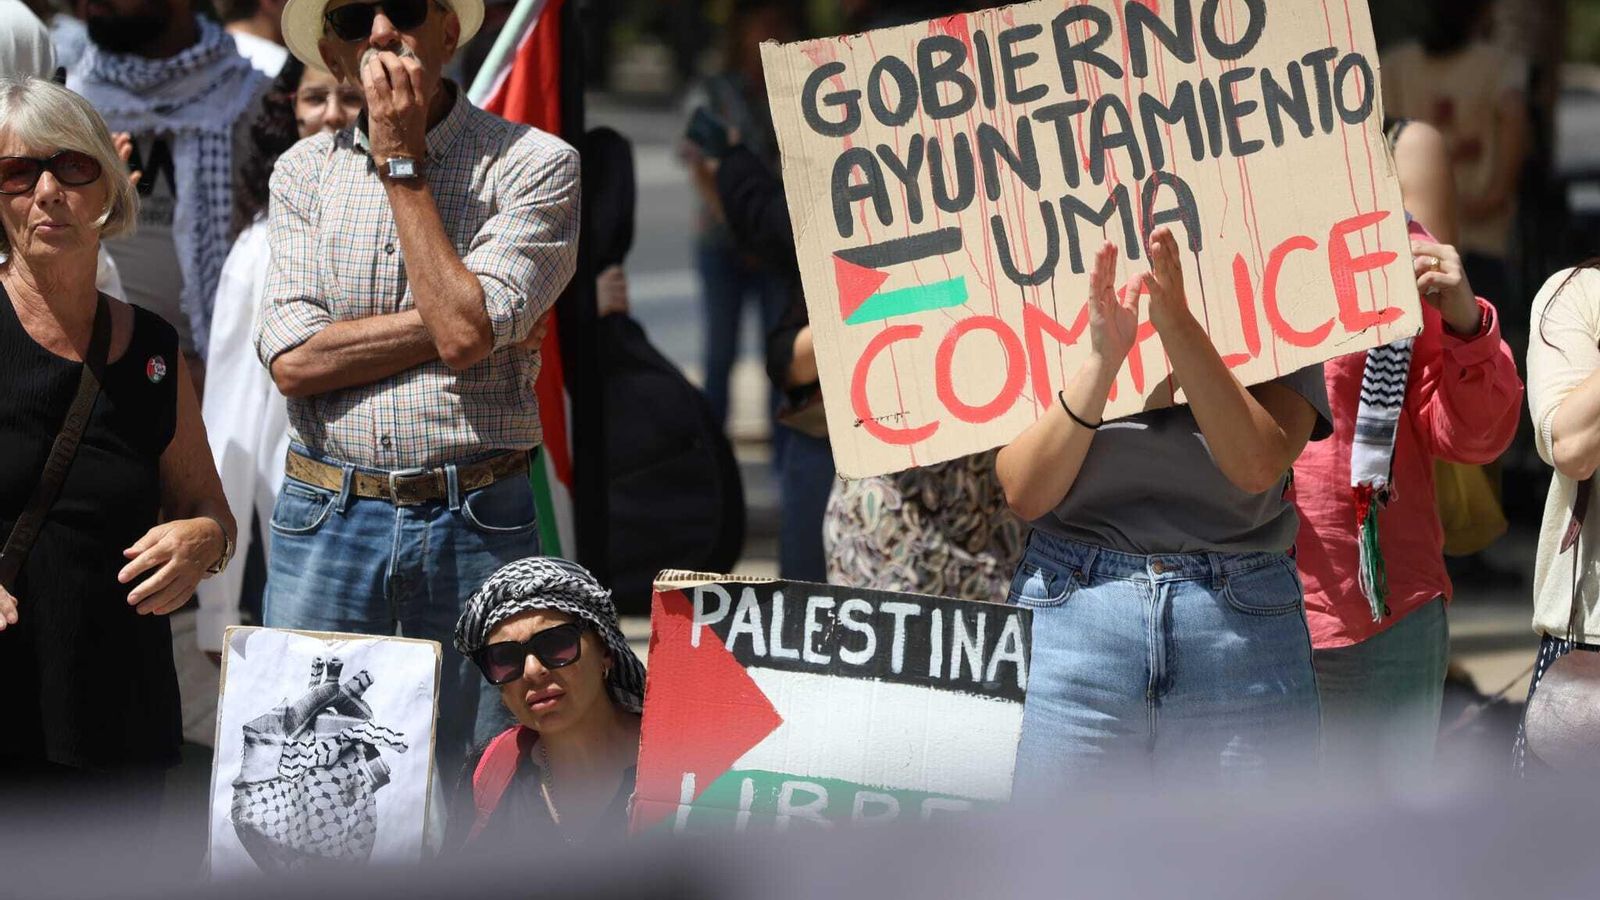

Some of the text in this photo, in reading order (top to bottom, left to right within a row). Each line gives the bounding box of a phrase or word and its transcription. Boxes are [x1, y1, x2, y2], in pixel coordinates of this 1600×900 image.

[801, 0, 1268, 138] GOBIERNO
[830, 46, 1376, 238] AYUNTAMIENTO
[990, 171, 1204, 287] UMA
[850, 210, 1406, 446] COMICE
[690, 584, 1030, 691] PALESTINA
